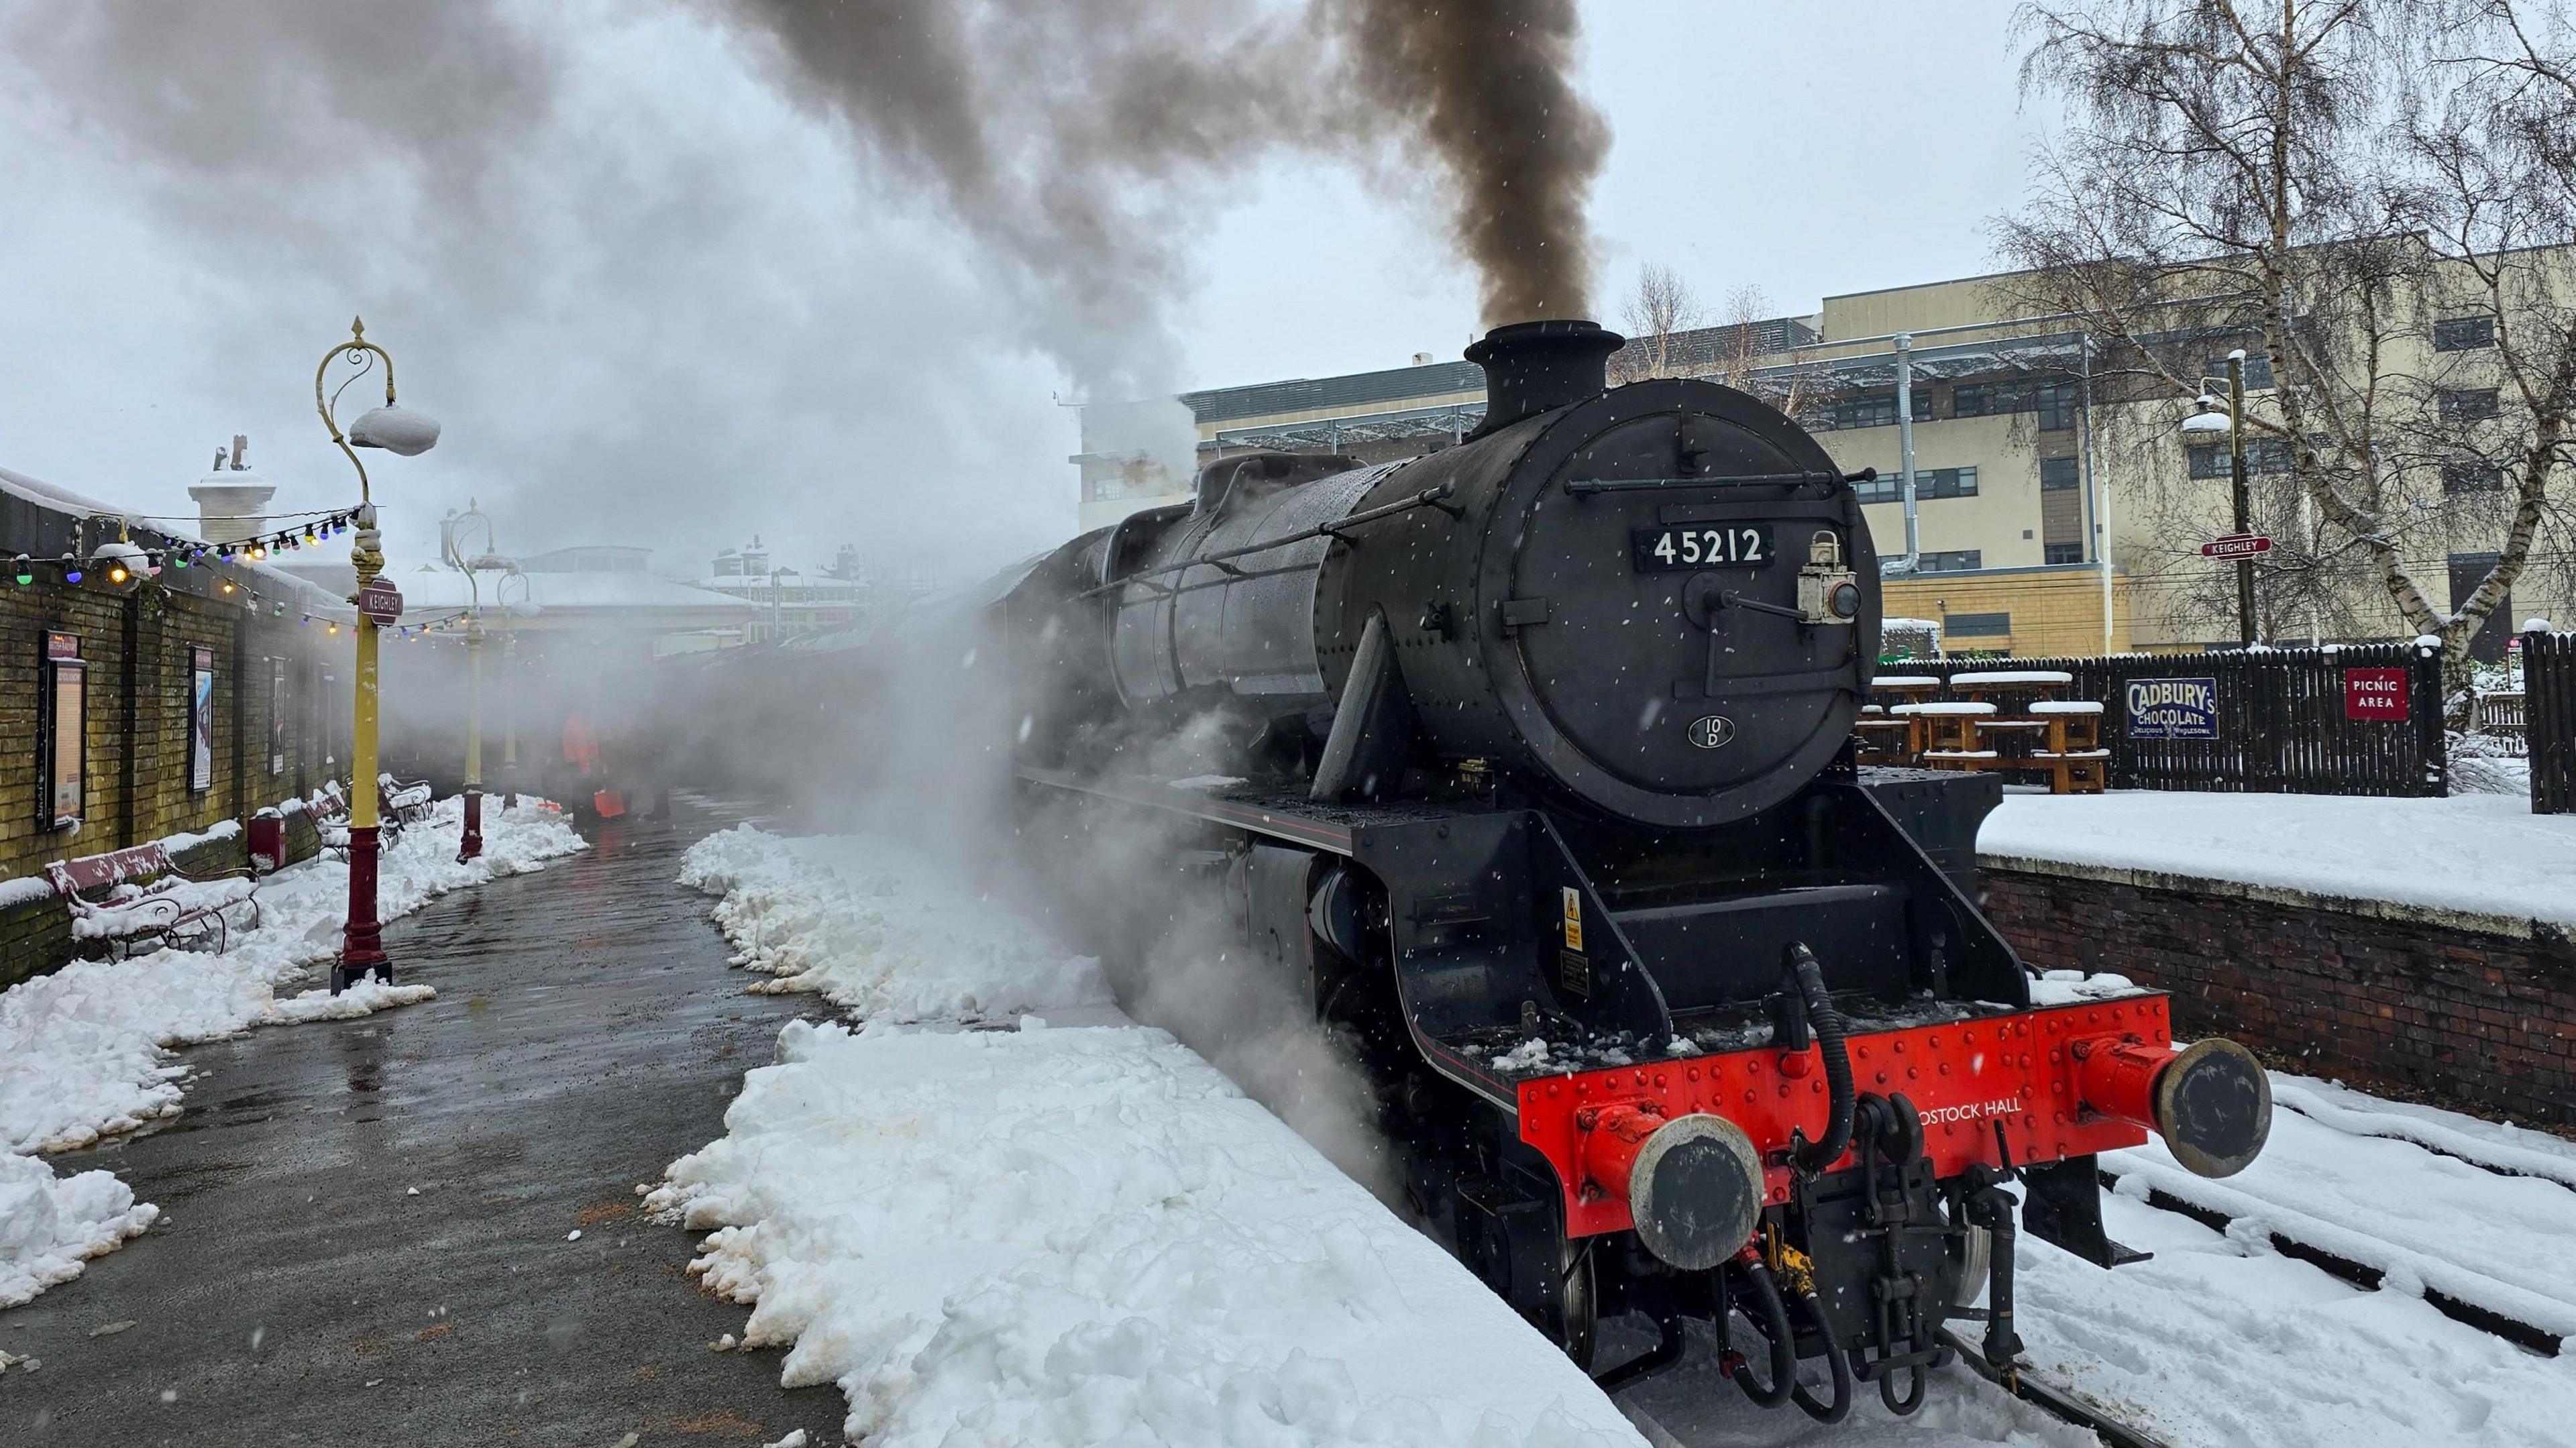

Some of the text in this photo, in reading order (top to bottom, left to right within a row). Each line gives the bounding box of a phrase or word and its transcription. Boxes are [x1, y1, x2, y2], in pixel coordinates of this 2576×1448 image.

[1654, 528, 1762, 565] 45212
[2212, 541, 2258, 554] KEIGHLEY
[369, 594, 398, 611] KEIGHLEY
[2353, 681, 2398, 691] PICNIC
[2129, 683, 2215, 716] CADBURY'S
[2359, 698, 2394, 708] AREA
[2138, 710, 2206, 725] CHOCOLATE
[1706, 718, 1721, 734] 10
[1707, 733, 1718, 746] D
[1919, 1097, 2023, 1126] OSTOCK HALL
